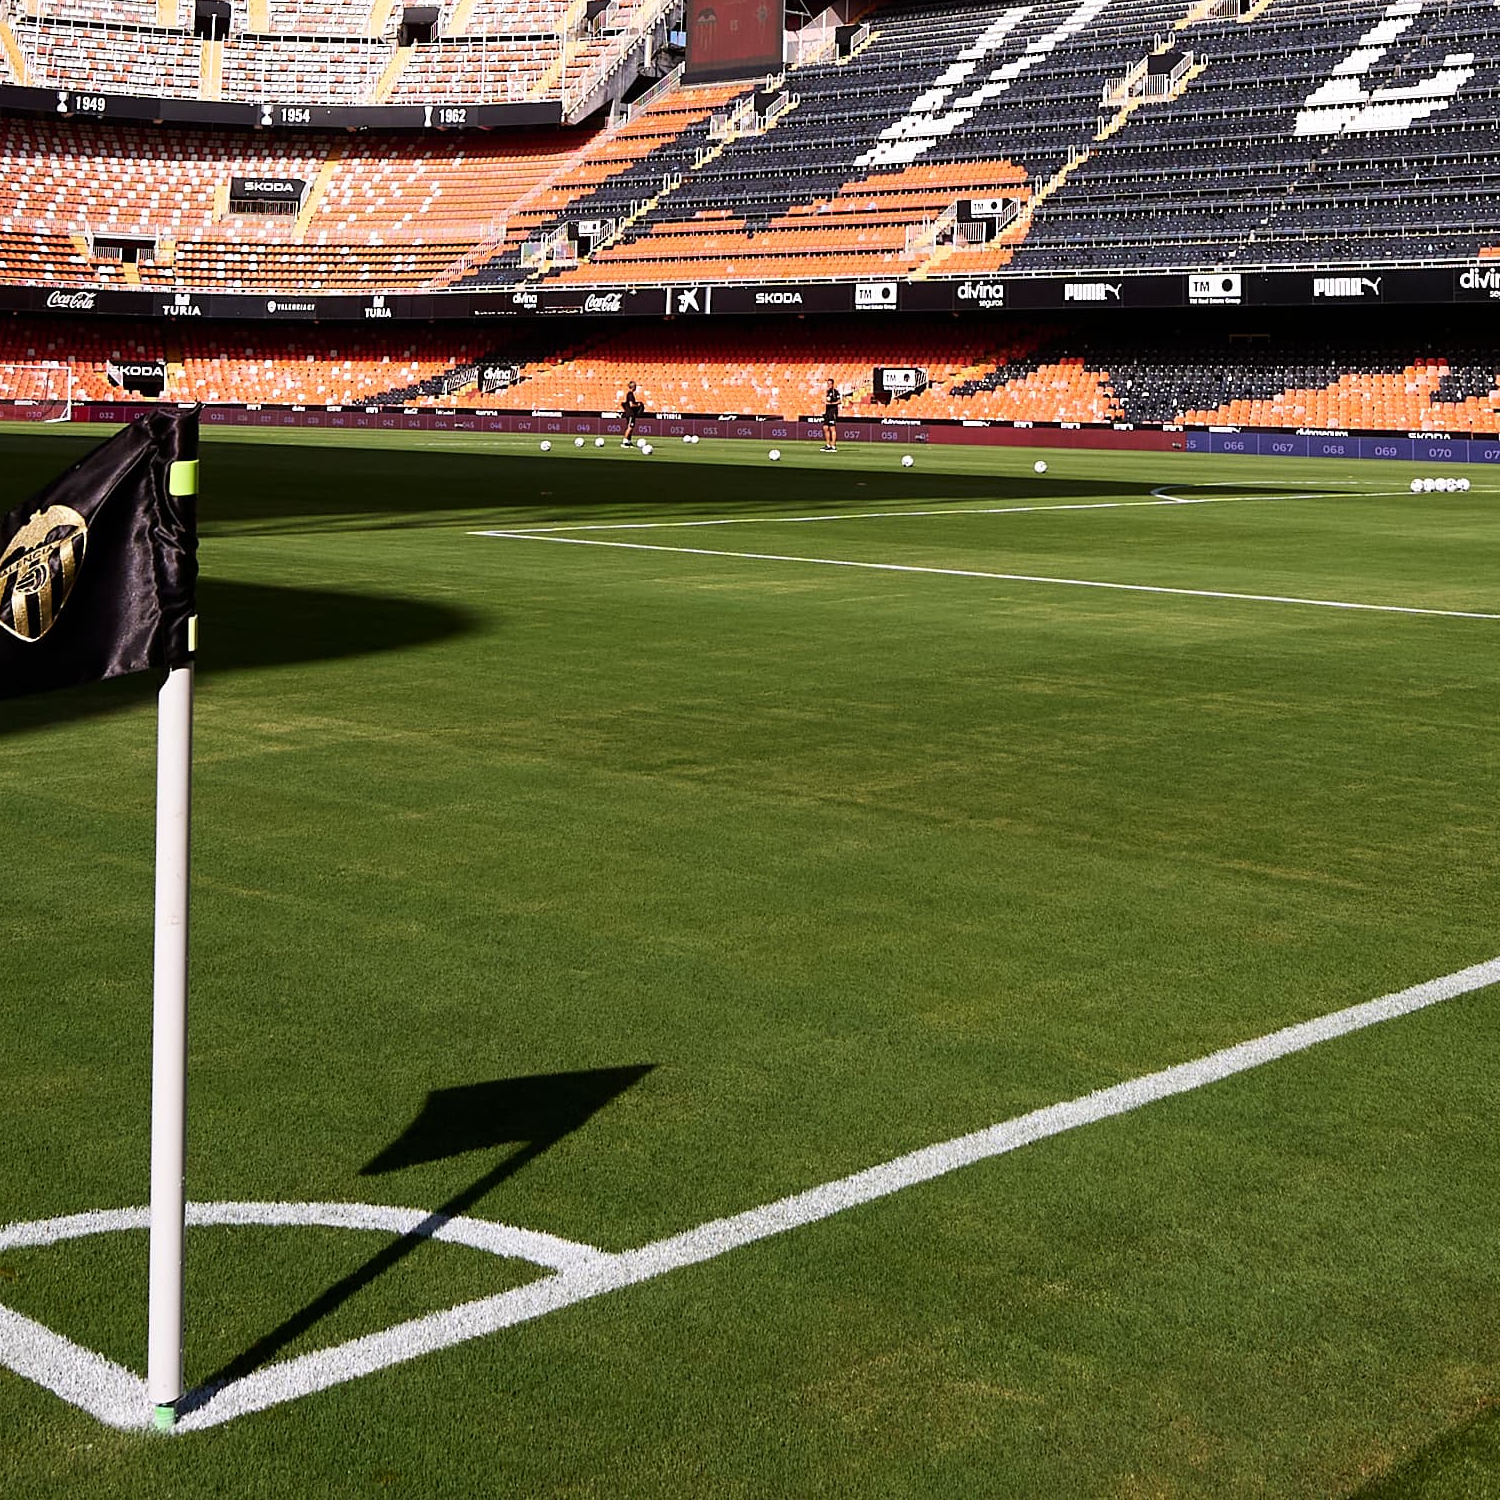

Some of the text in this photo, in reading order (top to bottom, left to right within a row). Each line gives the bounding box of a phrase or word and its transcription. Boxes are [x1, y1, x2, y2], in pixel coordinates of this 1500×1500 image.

[75, 96, 106, 112] 1949
[280, 107, 310, 124] 1954
[439, 108, 466, 123] 1962
[957, 281, 1004, 300] divina
[1194, 281, 1209, 291] TM
[1314, 278, 1362, 296] PUMA
[860, 290, 871, 298] TM
[1065, 283, 1107, 301] PUMA
[513, 292, 538, 304] divina
[162, 305, 201, 316] TURIA
[365, 307, 391, 318] TURIA
[483, 366, 512, 380] divina
[1224, 441, 1244, 451] 066
[1272, 443, 1293, 452] 067
[1323, 445, 1344, 454] 068
[1375, 447, 1397, 456] 069
[1429, 448, 1452, 458] 070
